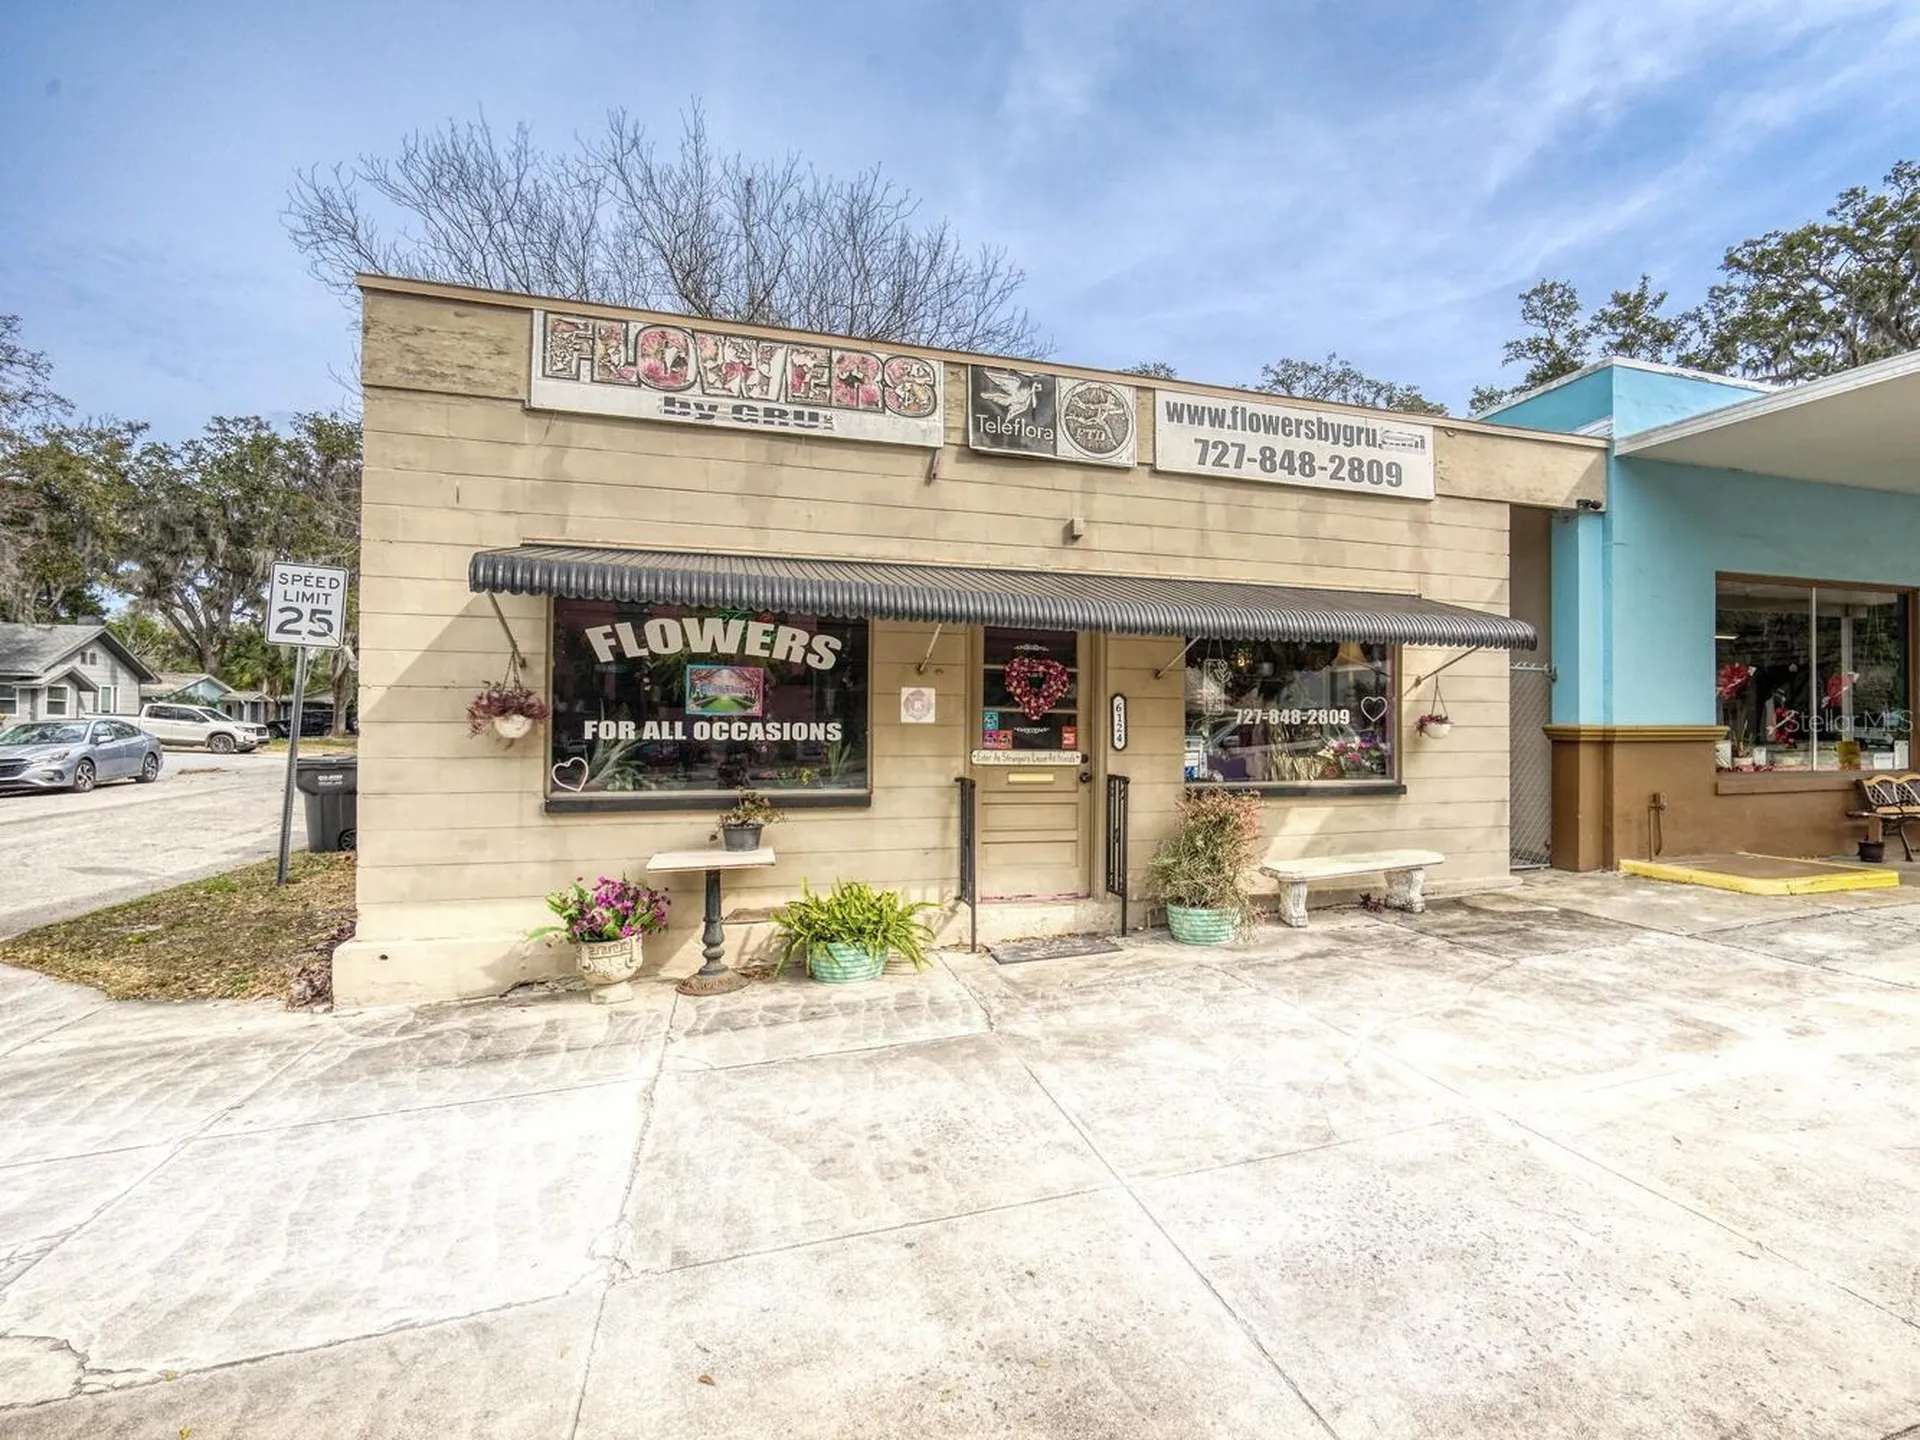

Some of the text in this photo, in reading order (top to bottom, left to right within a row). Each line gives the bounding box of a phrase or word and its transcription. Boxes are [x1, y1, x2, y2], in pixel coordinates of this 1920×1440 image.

[543, 312, 937, 418] FLOWERS
[663, 396, 718, 420] by
[731, 404, 820, 428] GRU
[975, 413, 1054, 443] Teleflora
[1194, 438, 1402, 488] 727-848-2809
[278, 572, 340, 590] SPEED
[283, 590, 332, 605] LIMIT
[275, 606, 333, 637] 25
[585, 617, 842, 670] FLOWERS
[584, 720, 842, 742] FOR ALL OCCASIONS
[1115, 702, 1123, 742] 6124
[1234, 708, 1350, 725] 727-848-2809
